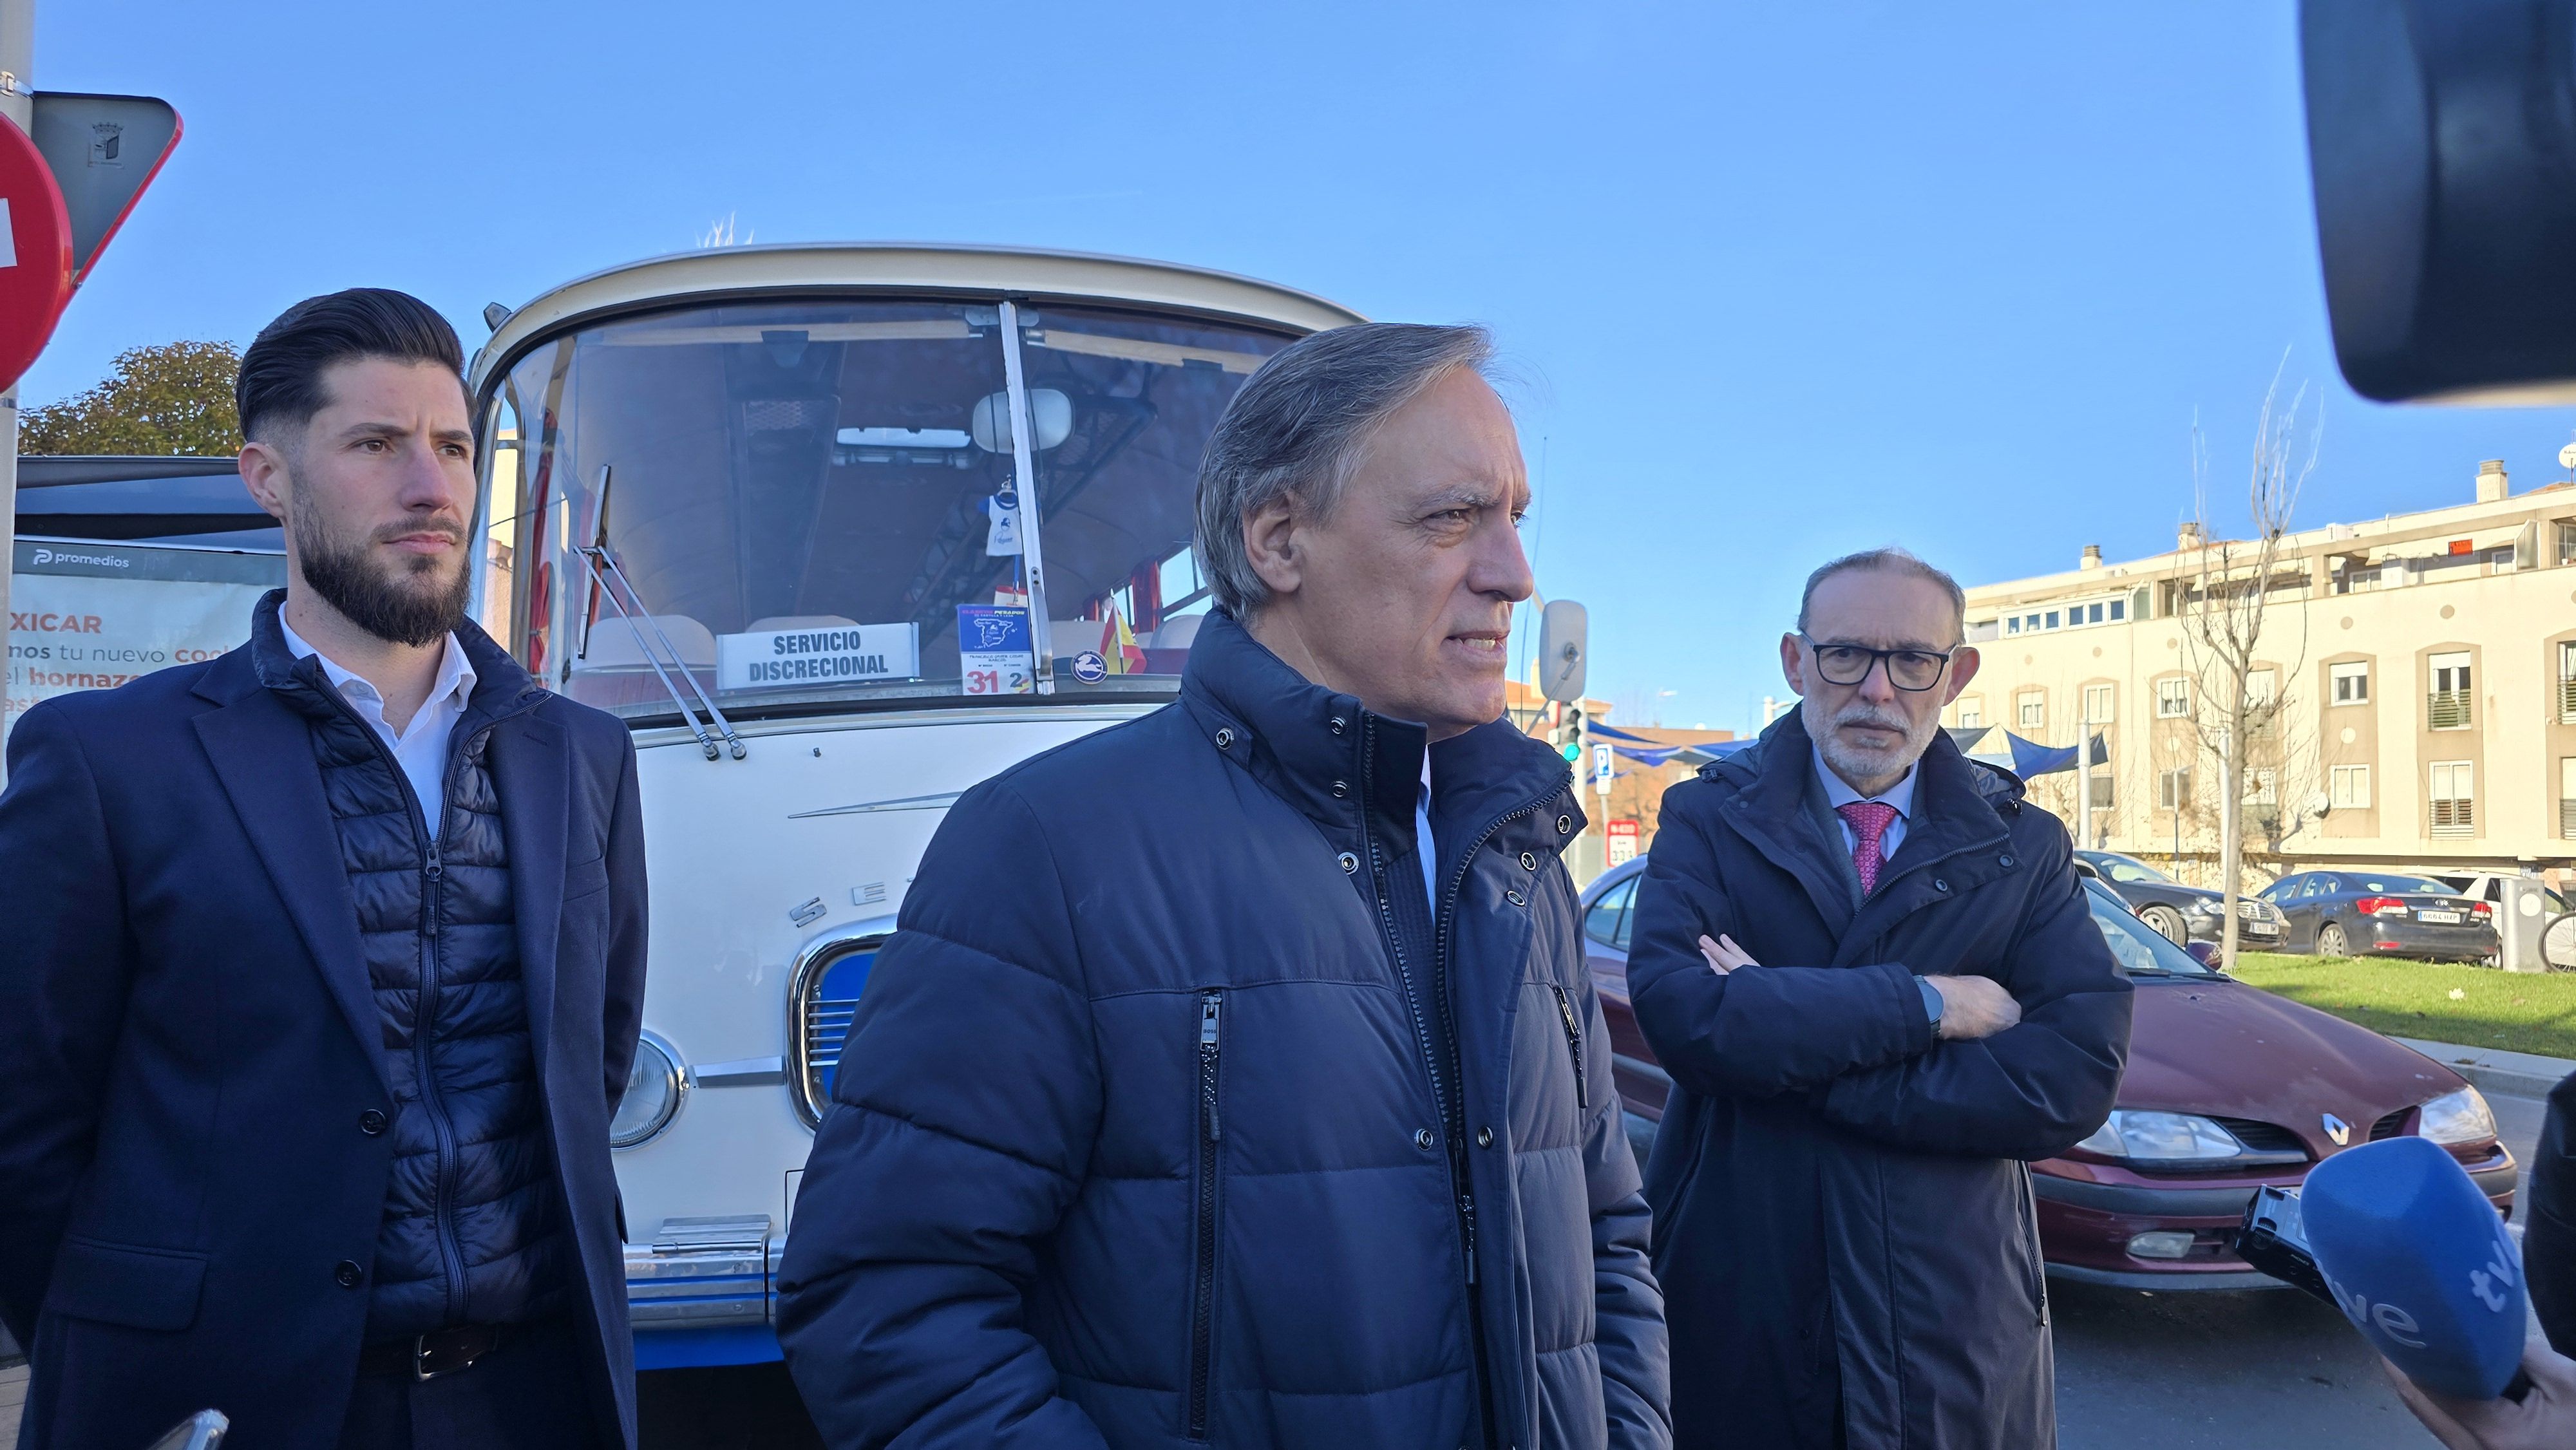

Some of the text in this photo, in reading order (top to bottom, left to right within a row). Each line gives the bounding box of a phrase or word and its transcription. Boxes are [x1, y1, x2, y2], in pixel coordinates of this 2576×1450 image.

[55, 553, 129, 568] promedios
[773, 630, 862, 655] SERVICIO
[61, 645, 83, 661] tu
[93, 648, 166, 663] nuevo
[175, 645, 229, 663] coc
[29, 666, 141, 688] hornaz
[749, 655, 889, 682] DISCRECIONAL
[967, 670, 999, 693] 31
[1009, 672, 1023, 688] 2
[790, 877, 914, 928] SE
